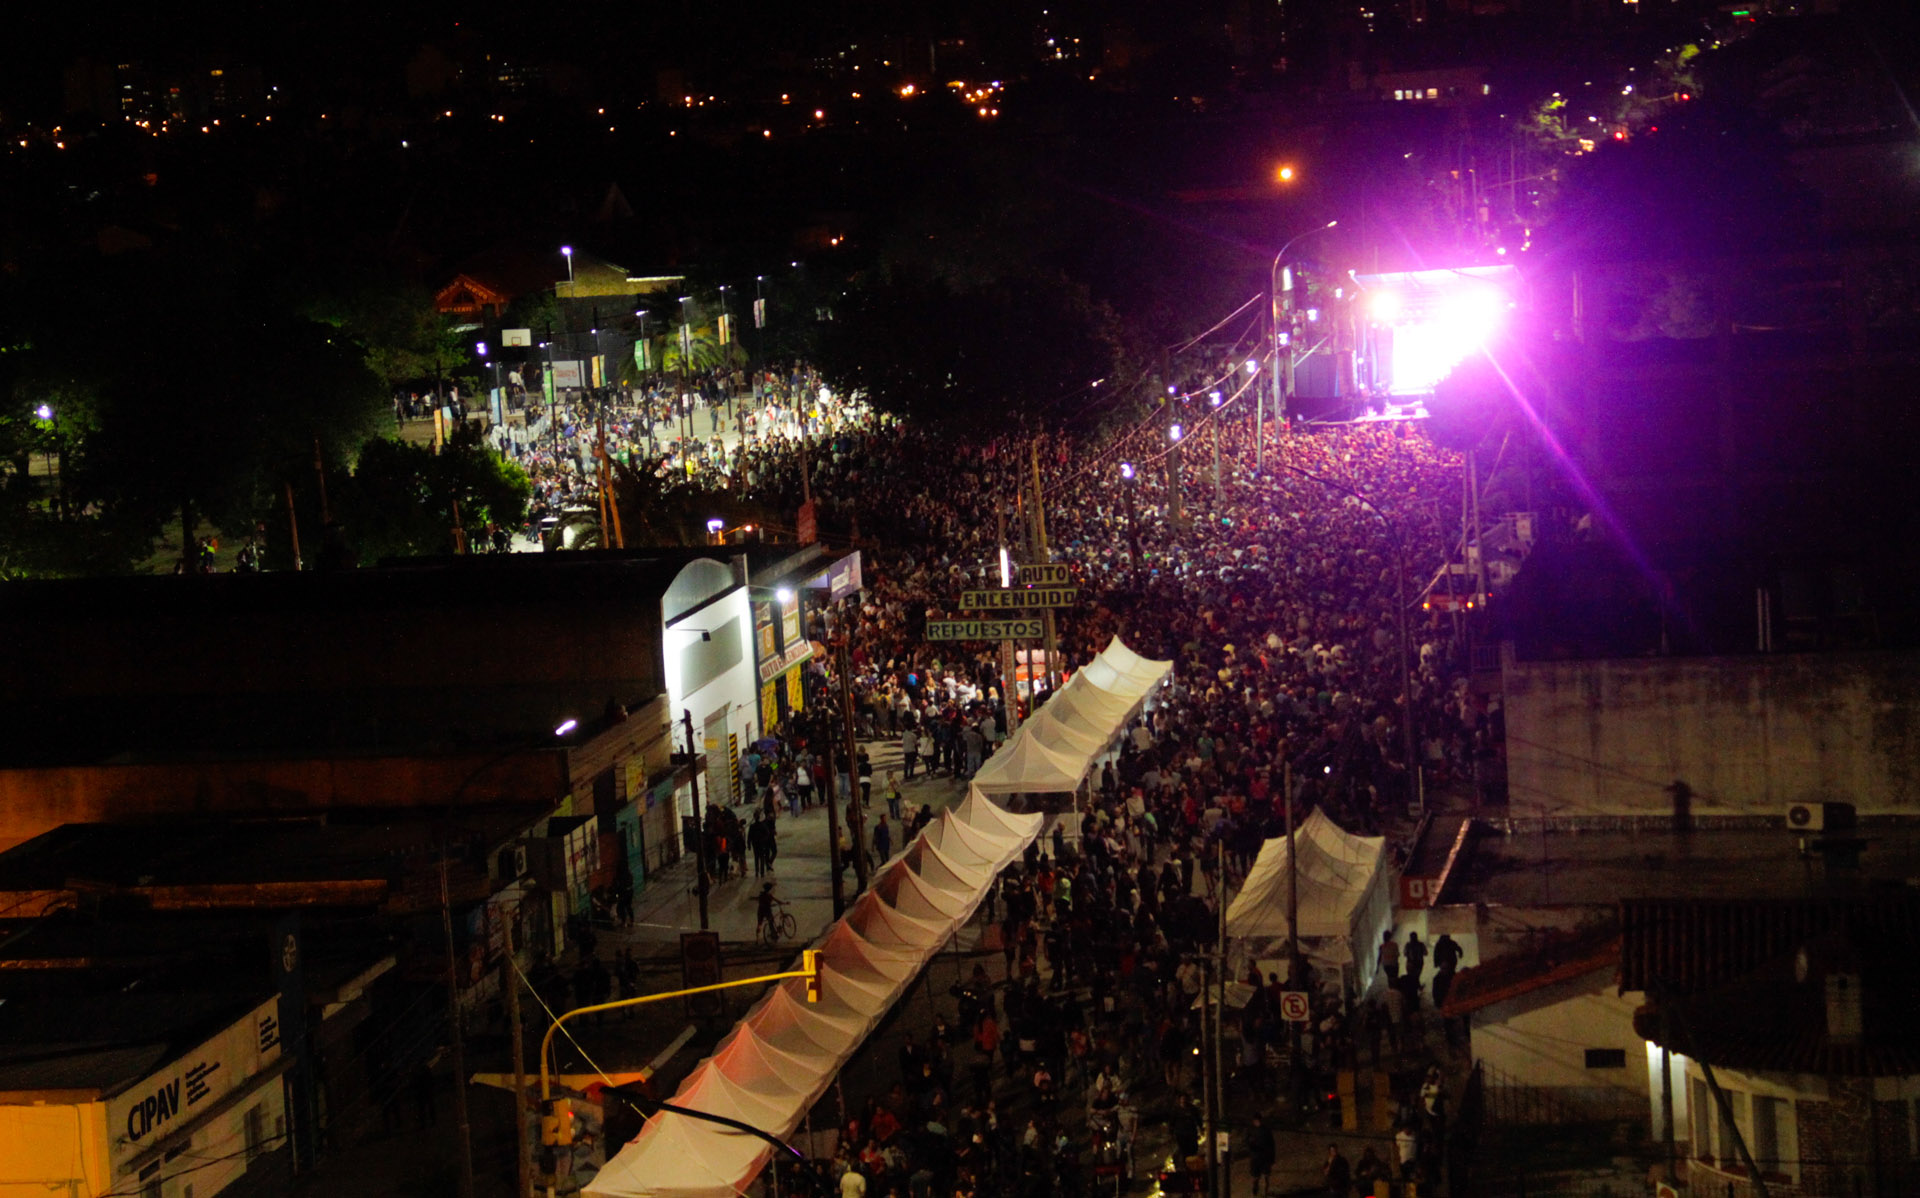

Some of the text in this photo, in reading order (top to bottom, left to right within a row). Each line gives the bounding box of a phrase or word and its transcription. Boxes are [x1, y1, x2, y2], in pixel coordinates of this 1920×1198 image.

[1022, 566, 1067, 583] AUTO
[963, 590, 1075, 607] ENCENDIDO
[928, 621, 1042, 639] REPUESTOS
[127, 1078, 180, 1141] CIPAV
